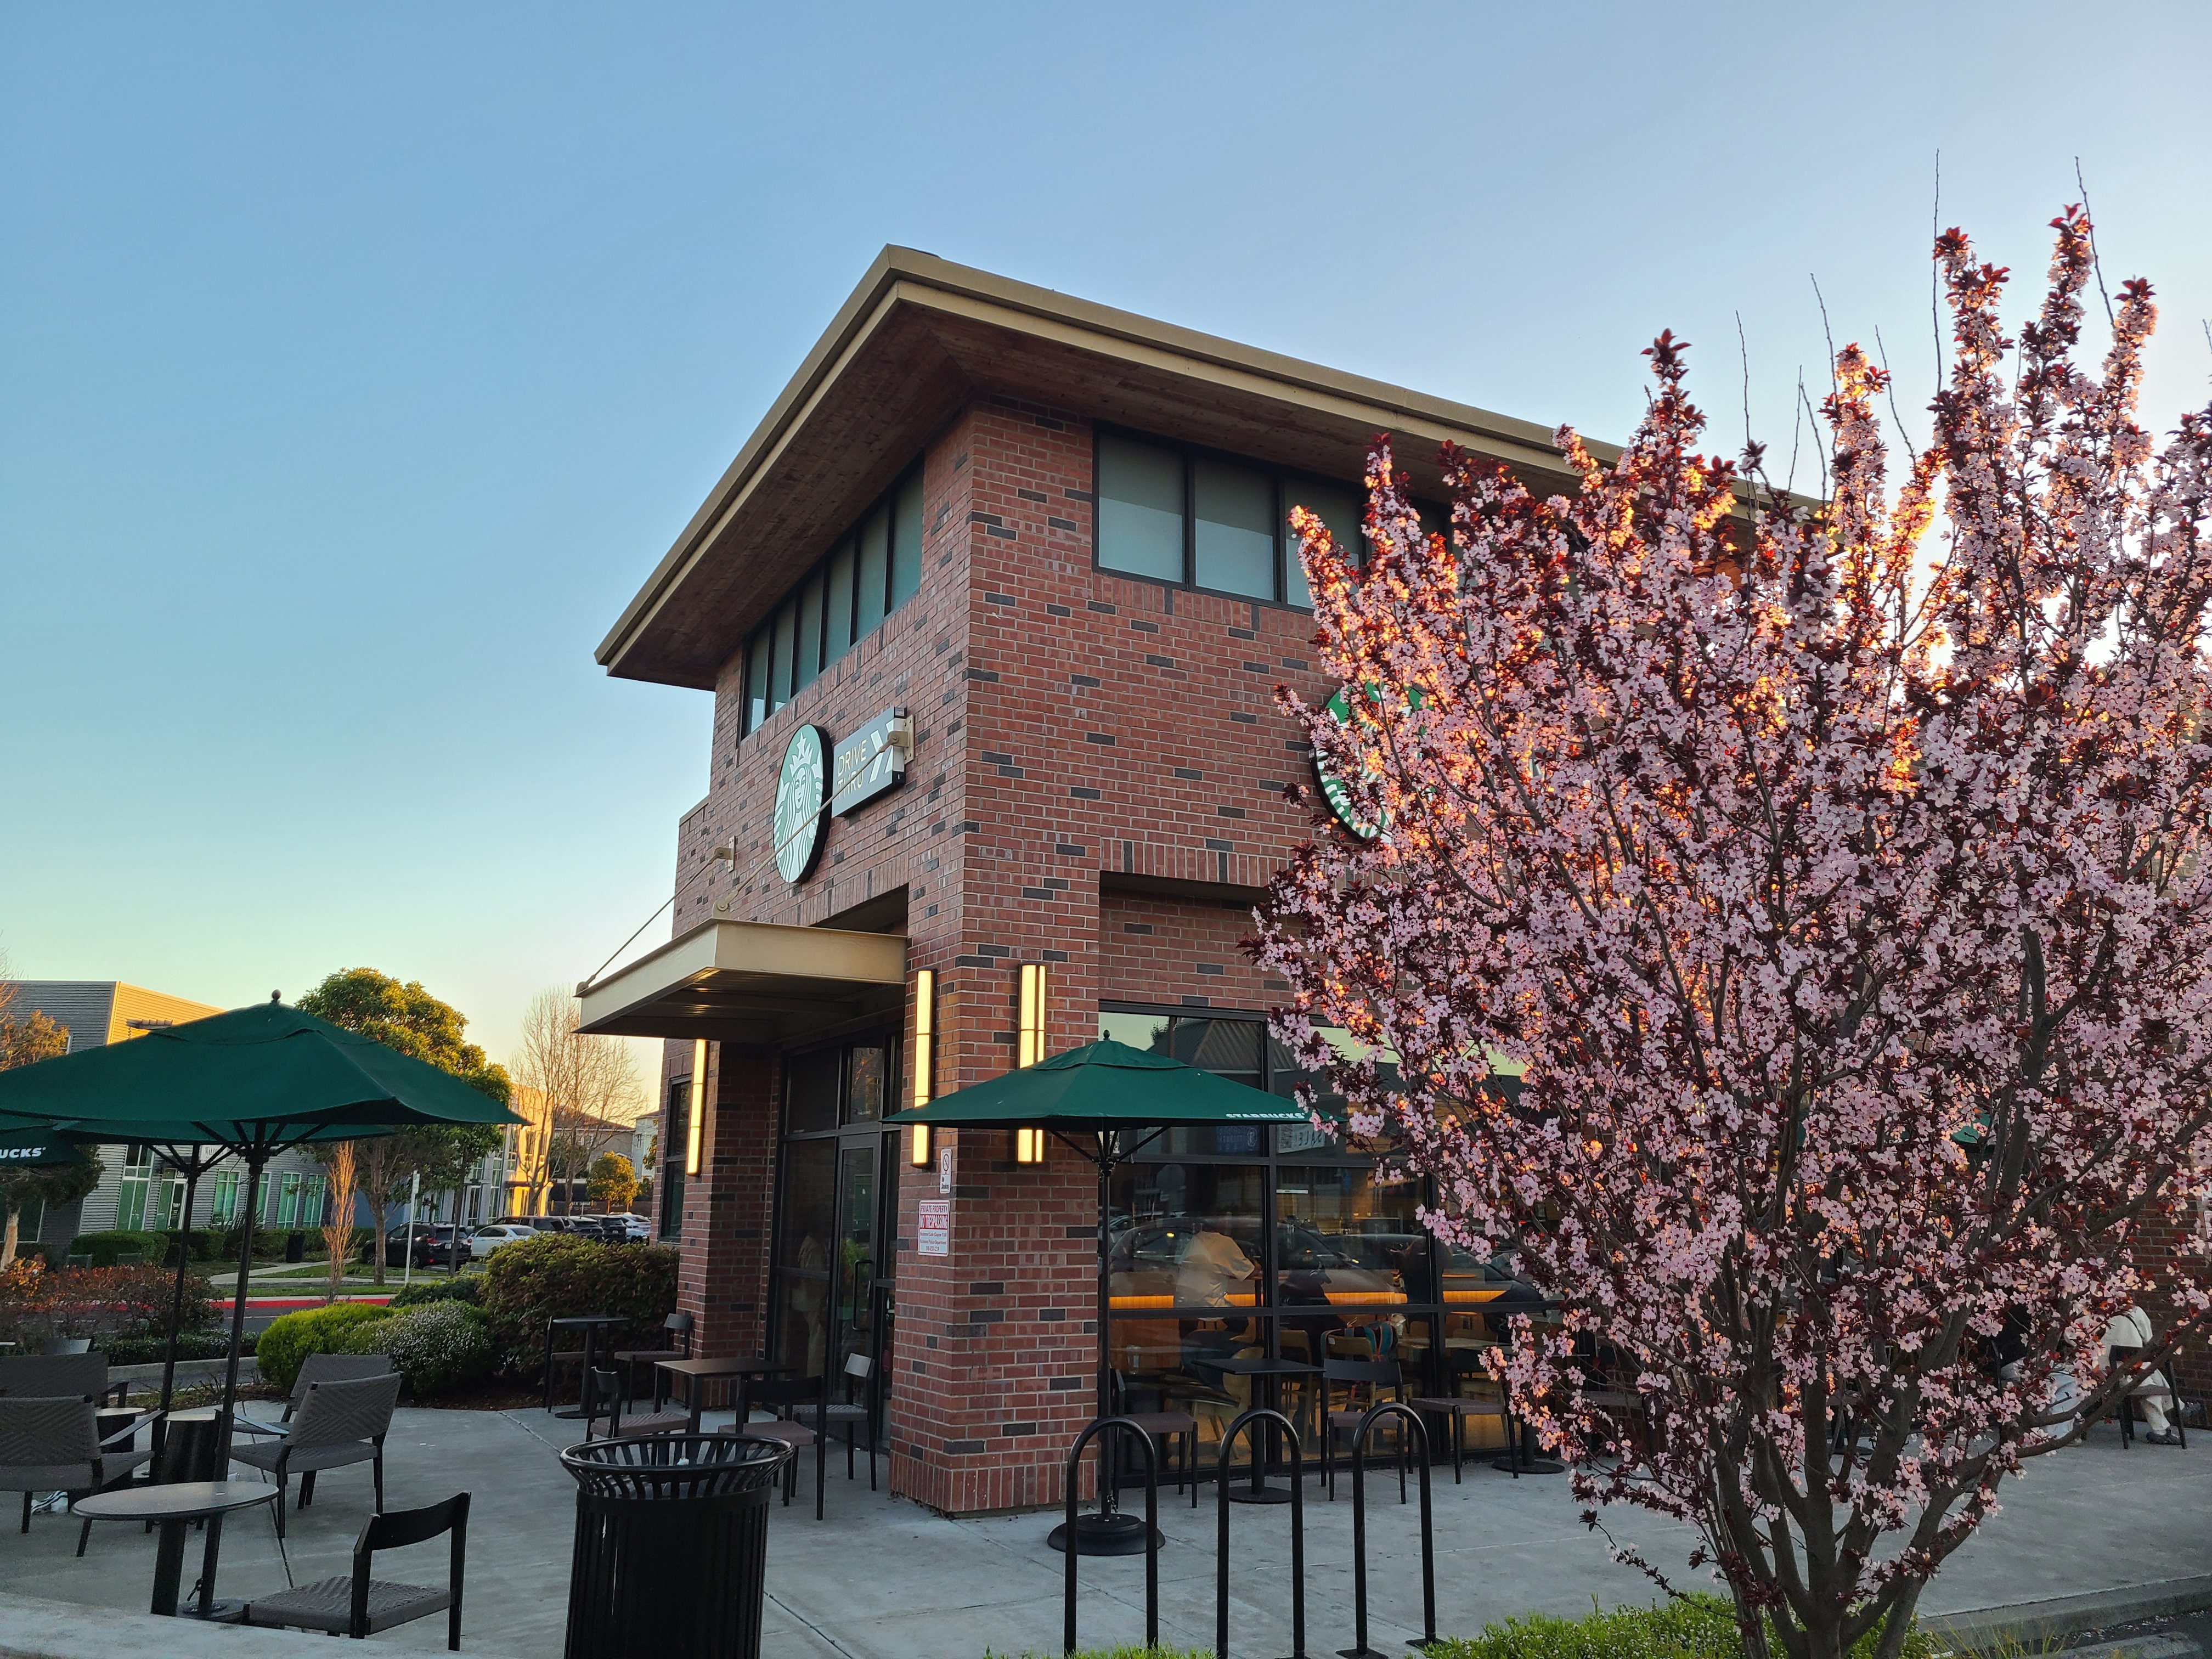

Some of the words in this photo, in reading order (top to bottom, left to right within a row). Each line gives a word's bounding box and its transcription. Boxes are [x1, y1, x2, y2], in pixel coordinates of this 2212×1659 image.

[838, 739, 867, 777] DRIVE
[837, 765, 864, 800] THRU
[920, 1215, 925, 1228] NO
[926, 1215, 948, 1228] TRESPASSING
